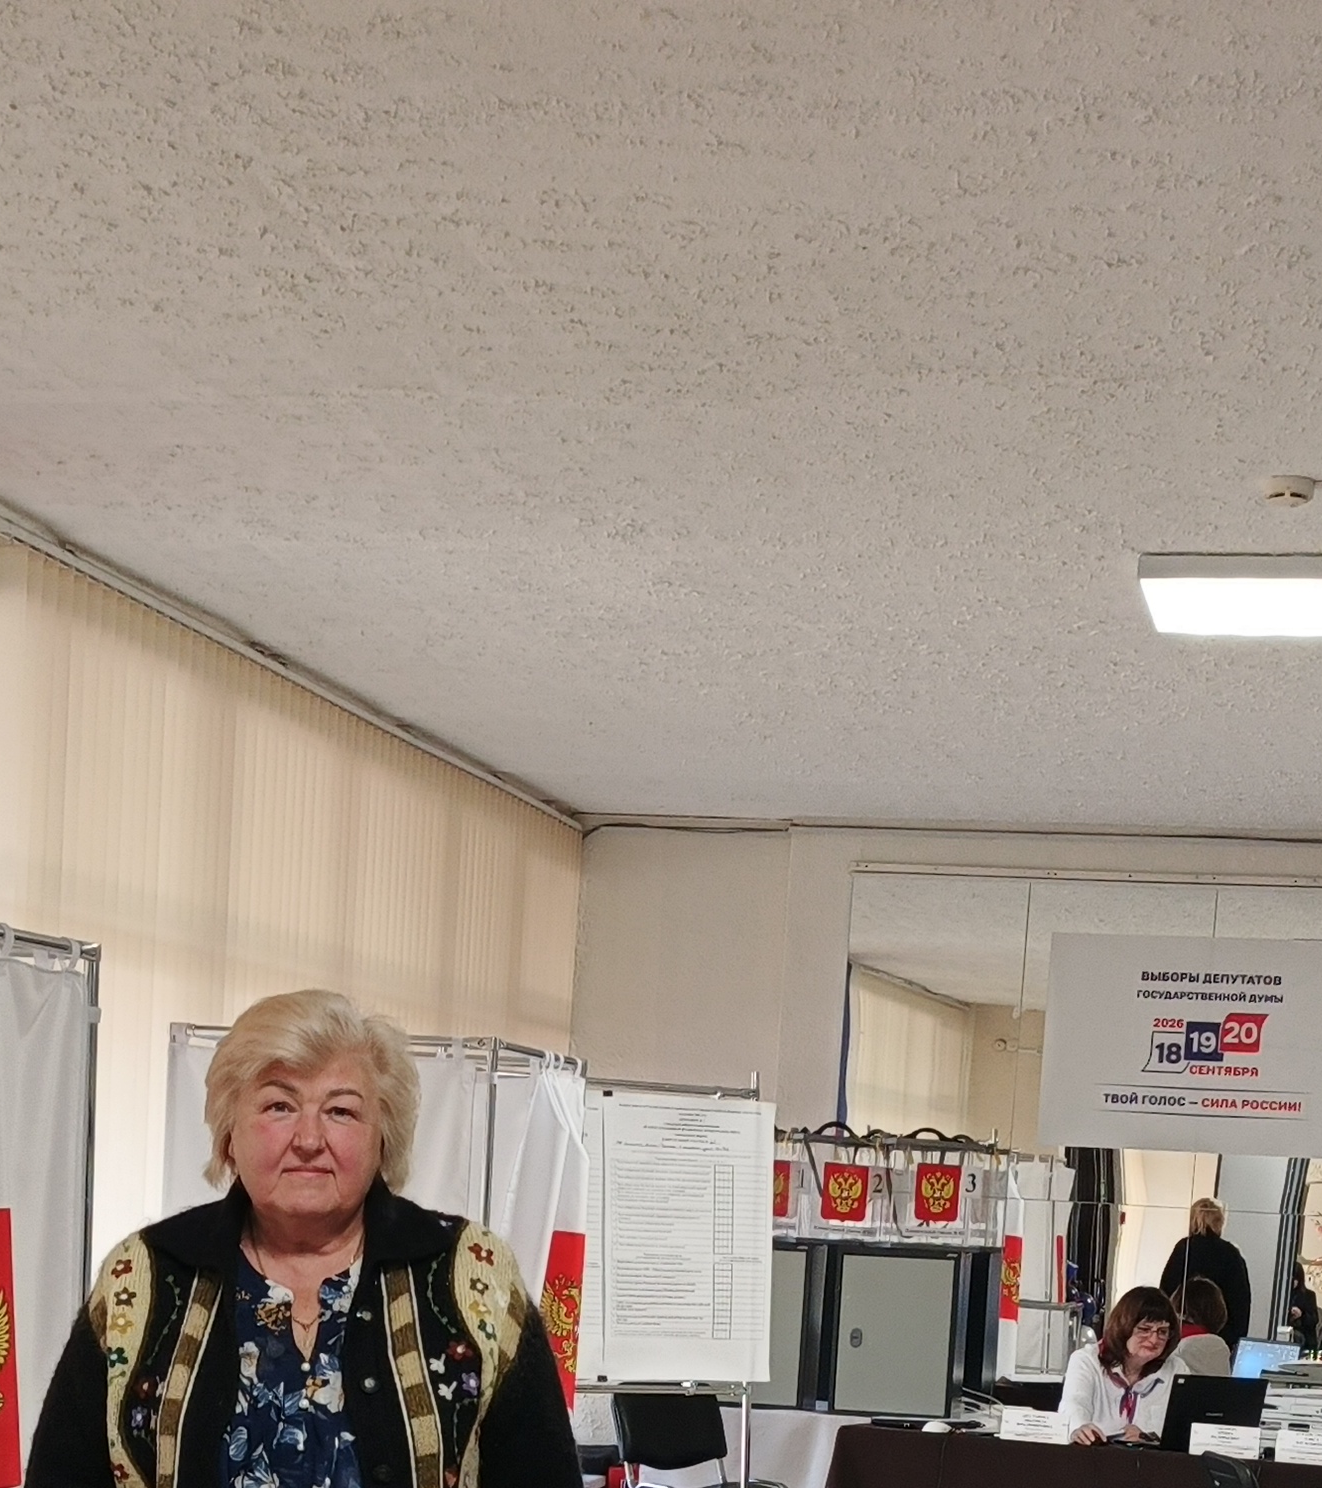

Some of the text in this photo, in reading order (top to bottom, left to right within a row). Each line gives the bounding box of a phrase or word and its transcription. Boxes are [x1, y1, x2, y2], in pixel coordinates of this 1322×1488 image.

[1141, 971, 1282, 986] ВЫБОРЫ ДЕПУТАТОВ
[1136, 989, 1283, 1004] ГОСУДАРСТВЕННОЙ ДУМЫ
[1153, 1018, 1184, 1029] 2026
[1155, 1022, 1258, 1064] 18 19 20
[1189, 1065, 1259, 1077] СЕНТЯБРЯ
[1103, 1092, 1139, 1105] ТВОЙ
[1141, 1094, 1186, 1107] ГОЛОС
[1201, 1098, 1238, 1109] СИЛА
[1241, 1099, 1302, 1112] РОССИИ!
[872, 1174, 883, 1194] 2
[965, 1173, 977, 1194] 3
